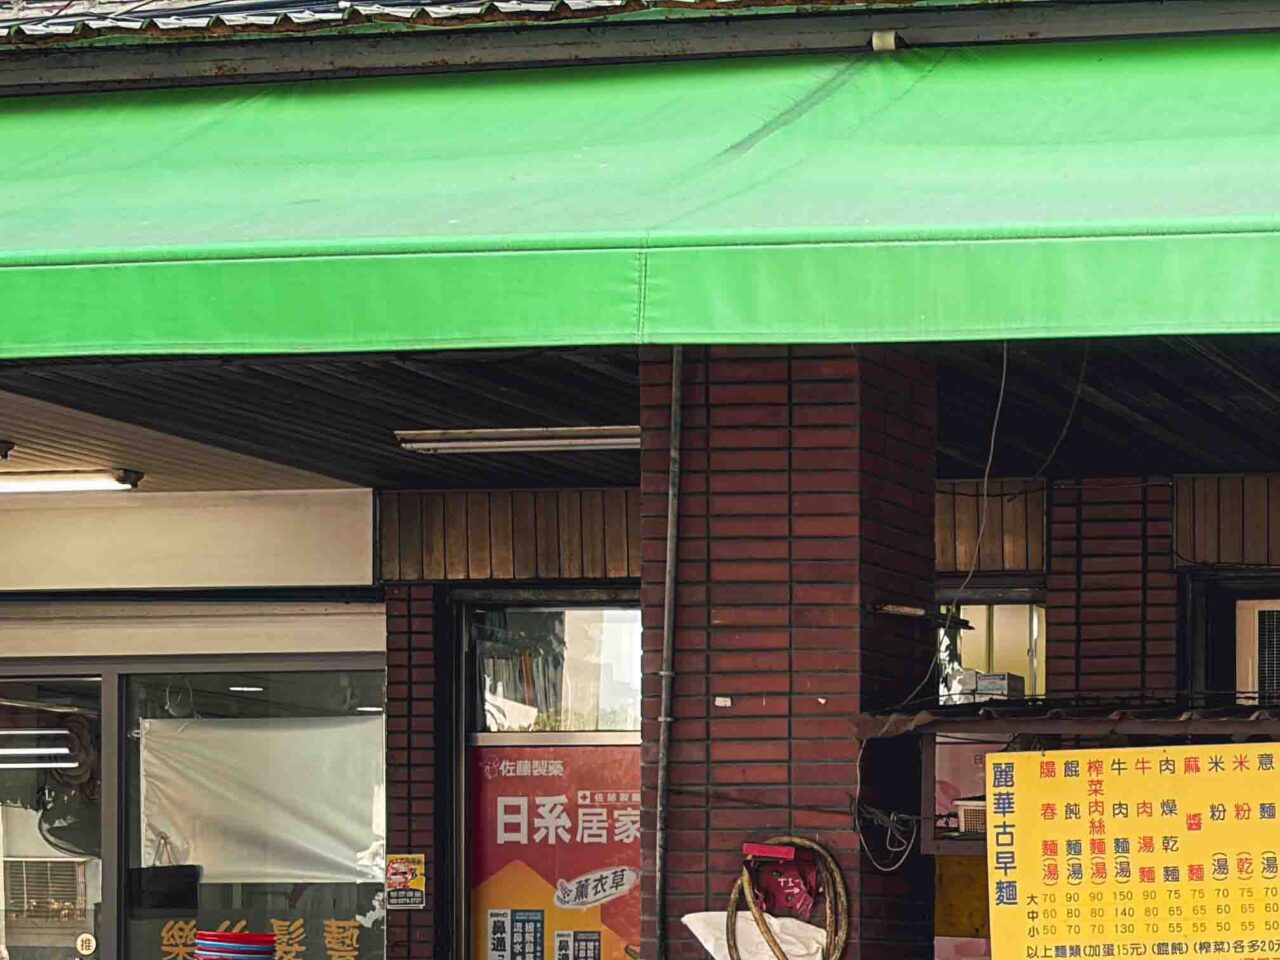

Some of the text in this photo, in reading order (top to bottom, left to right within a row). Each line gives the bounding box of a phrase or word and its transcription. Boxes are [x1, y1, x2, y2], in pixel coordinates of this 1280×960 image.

[992, 762, 1018, 906] 麗華古早麵
[1135, 757, 1155, 883] 牛肉湯麵
[1159, 757, 1180, 883] 肉燥乾麵
[1183, 756, 1205, 882] 麻醬麵
[1026, 894, 1038, 905] 大
[1042, 893, 1056, 903] 70
[1065, 892, 1080, 902] 90
[1089, 892, 1103, 902] 90
[1113, 891, 1133, 901] 150
[1143, 890, 1157, 900] 90
[1166, 890, 1181, 899] 75
[1190, 889, 1205, 899] 75
[1215, 888, 1229, 898] 70
[1239, 887, 1253, 897] 75
[1264, 887, 1278, 897] 70
[1027, 910, 1038, 922] 中
[1042, 909, 1057, 919] 60
[1066, 908, 1080, 918] 80
[1090, 908, 1104, 918] 80
[1115, 907, 1135, 917] 140
[1144, 907, 1158, 917] 80
[1168, 906, 1183, 916] 65
[1192, 905, 1206, 915] 65
[1216, 904, 1231, 914] 60
[1240, 903, 1254, 913] 65
[1264, 903, 1279, 913] 60
[1028, 926, 1039, 938] 小
[1042, 925, 1056, 935] 50
[1067, 925, 1080, 935] 70
[1090, 924, 1104, 934] 70
[1114, 924, 1135, 934] 130
[1144, 923, 1159, 933] 70
[1168, 923, 1183, 933] 55
[1192, 922, 1206, 932] 55
[1216, 922, 1231, 932] 50
[1240, 921, 1255, 931] 55
[1264, 920, 1279, 930] 50
